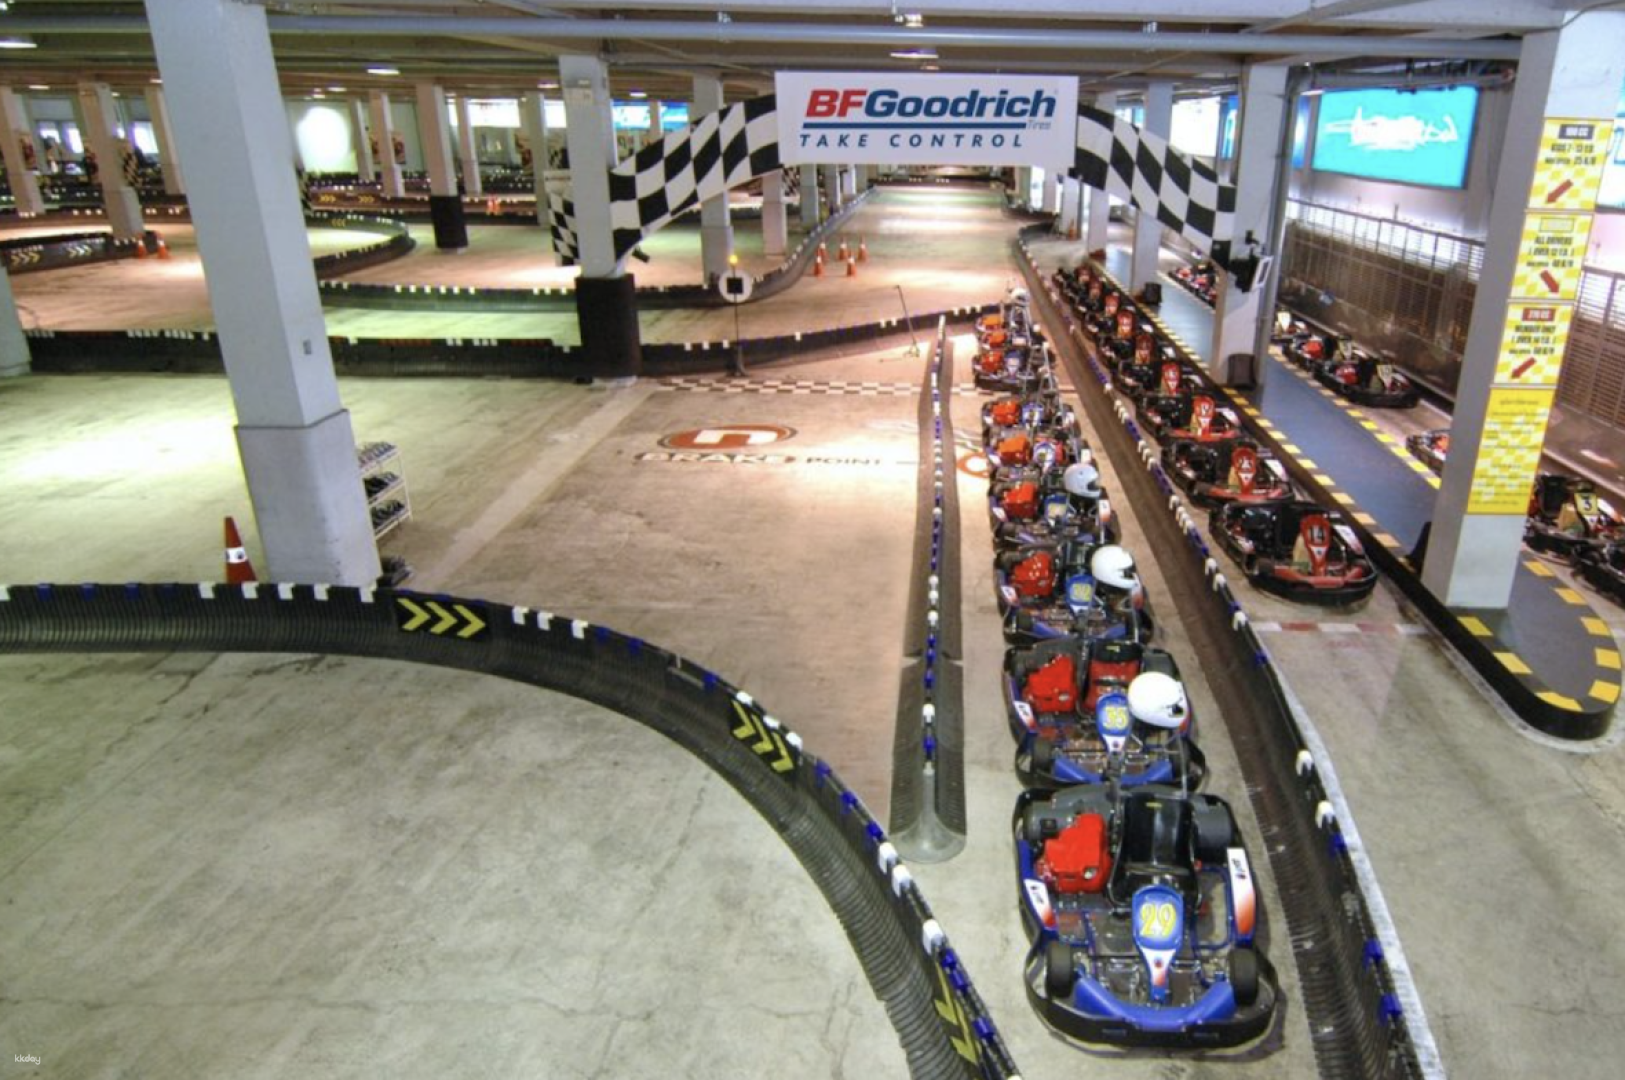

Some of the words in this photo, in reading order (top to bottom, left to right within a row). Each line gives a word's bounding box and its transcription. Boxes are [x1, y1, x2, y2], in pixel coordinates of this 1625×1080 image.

[805, 89, 1057, 118] BFGoodrich
[799, 133, 869, 148] TAKE
[889, 133, 1023, 148] CONTROL
[805, 456, 882, 465] POINT
[1140, 902, 1177, 938] 29
